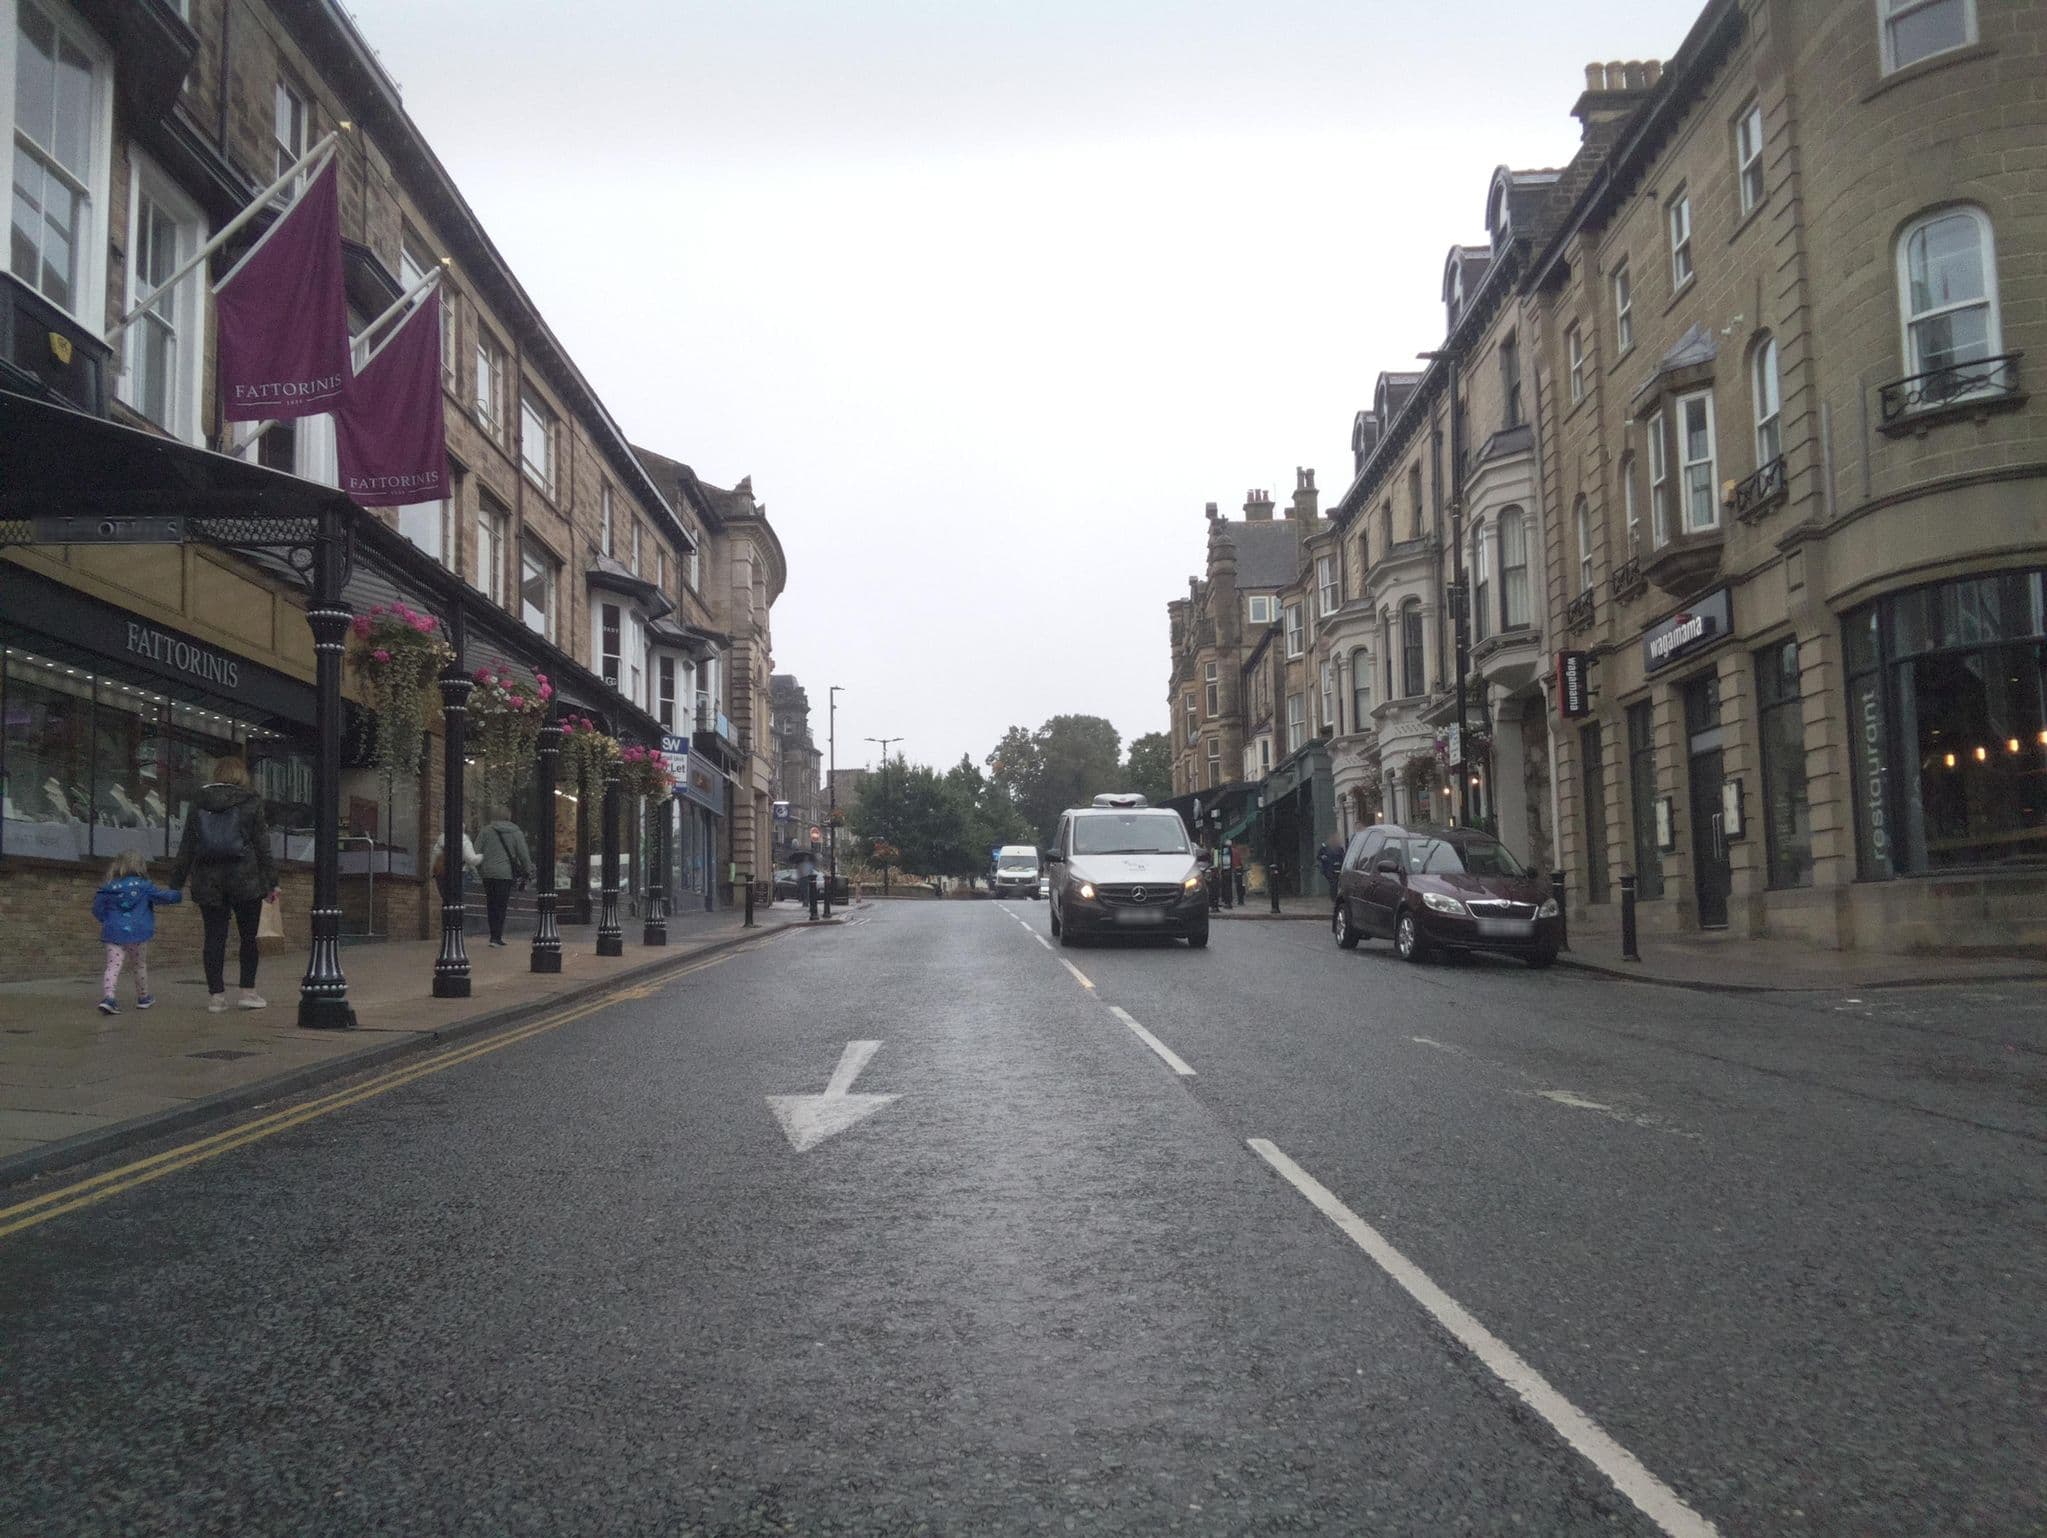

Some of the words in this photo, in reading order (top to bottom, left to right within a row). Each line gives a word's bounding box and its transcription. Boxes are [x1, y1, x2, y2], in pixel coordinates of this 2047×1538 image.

[235, 373, 342, 398] FATTORINIS
[349, 470, 440, 489] FATTORINIS
[1650, 615, 1704, 659] wagamama
[125, 620, 239, 689] FATTORINIS
[1565, 656, 1579, 712] wagamama
[662, 737, 681, 752] SW
[670, 763, 686, 773] Let
[1861, 689, 1887, 861] restaurant
